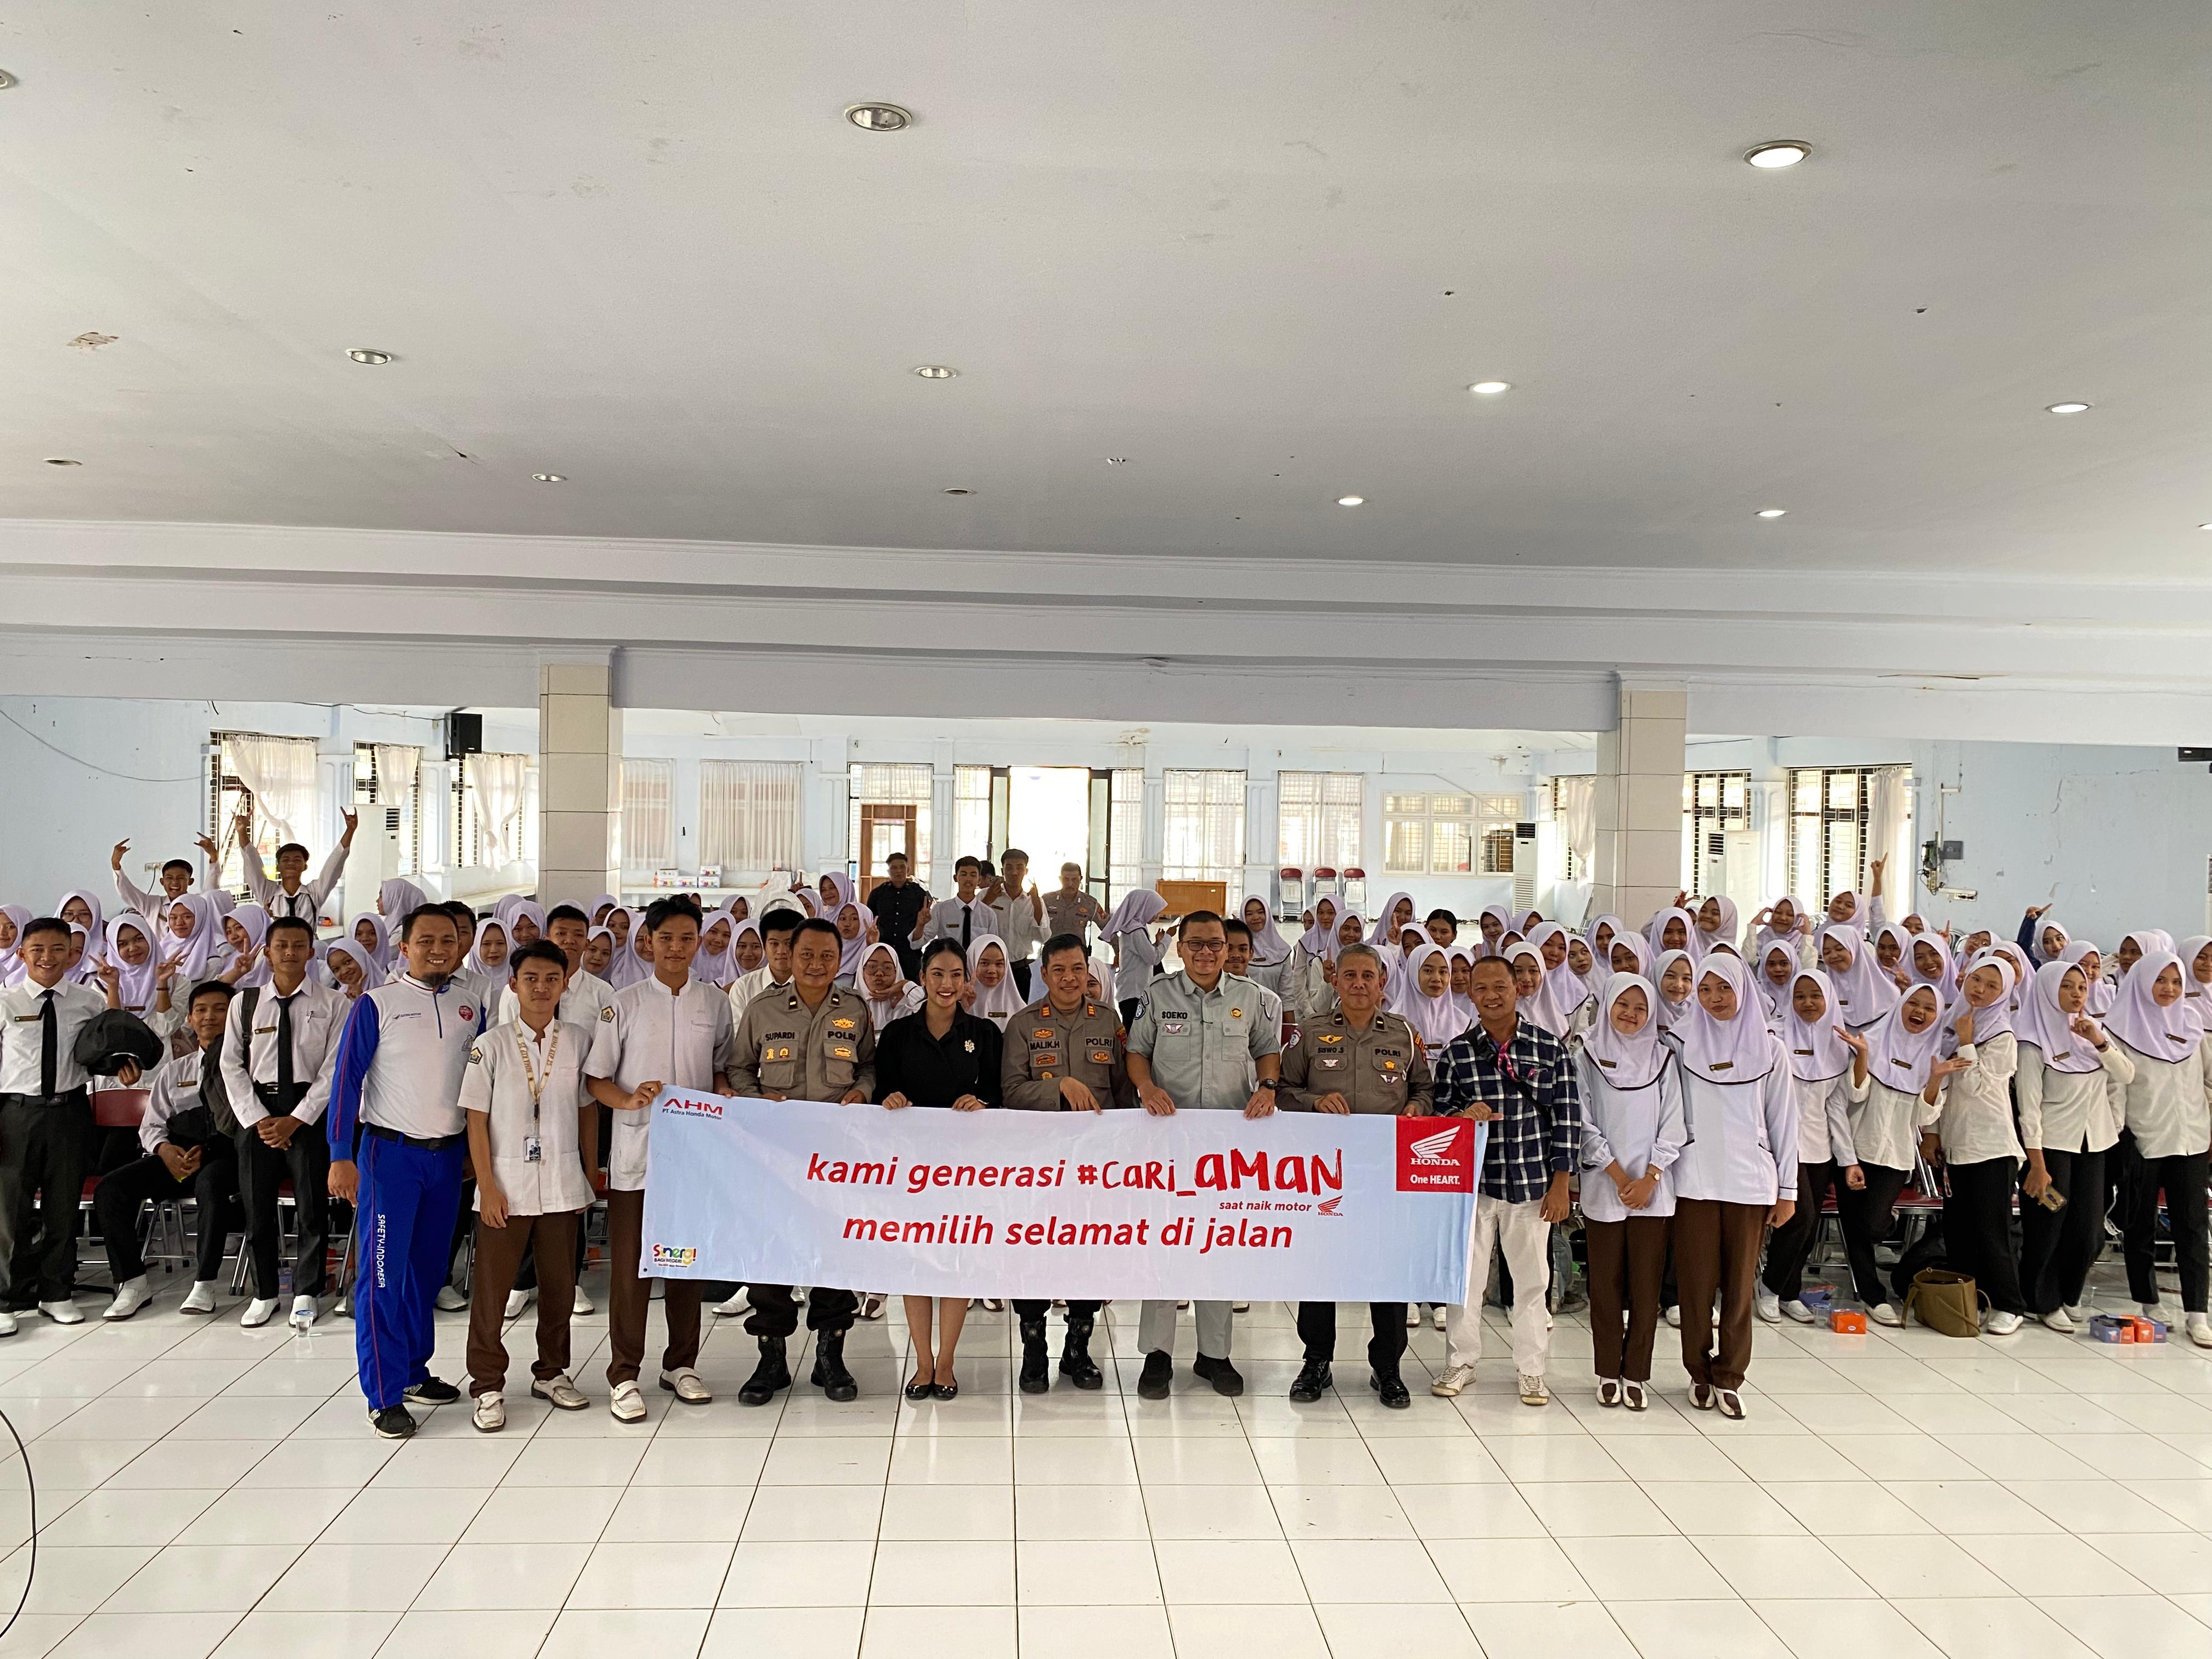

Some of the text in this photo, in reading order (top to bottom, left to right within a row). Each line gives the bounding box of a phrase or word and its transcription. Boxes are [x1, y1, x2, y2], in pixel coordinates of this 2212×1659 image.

[1161, 1011, 1188, 1020] SOEKO
[765, 1031, 795, 1041] SUPARDI
[827, 1031, 856, 1042] POLRI
[1030, 1040, 1060, 1050] MALIK.H
[1086, 1038, 1112, 1047] POLRI
[1374, 1048, 1401, 1057] POLRI
[663, 1098, 723, 1115] AHM
[685, 1109, 704, 1118] Honda
[1410, 1158, 1461, 1166] HONDA
[808, 1153, 898, 1185] kami
[907, 1159, 1065, 1193] generasi
[1410, 1174, 1460, 1185] One HEART.
[1218, 1200, 1312, 1212] saat naik motor
[843, 1215, 1293, 1254] memilih selamat di jalan
